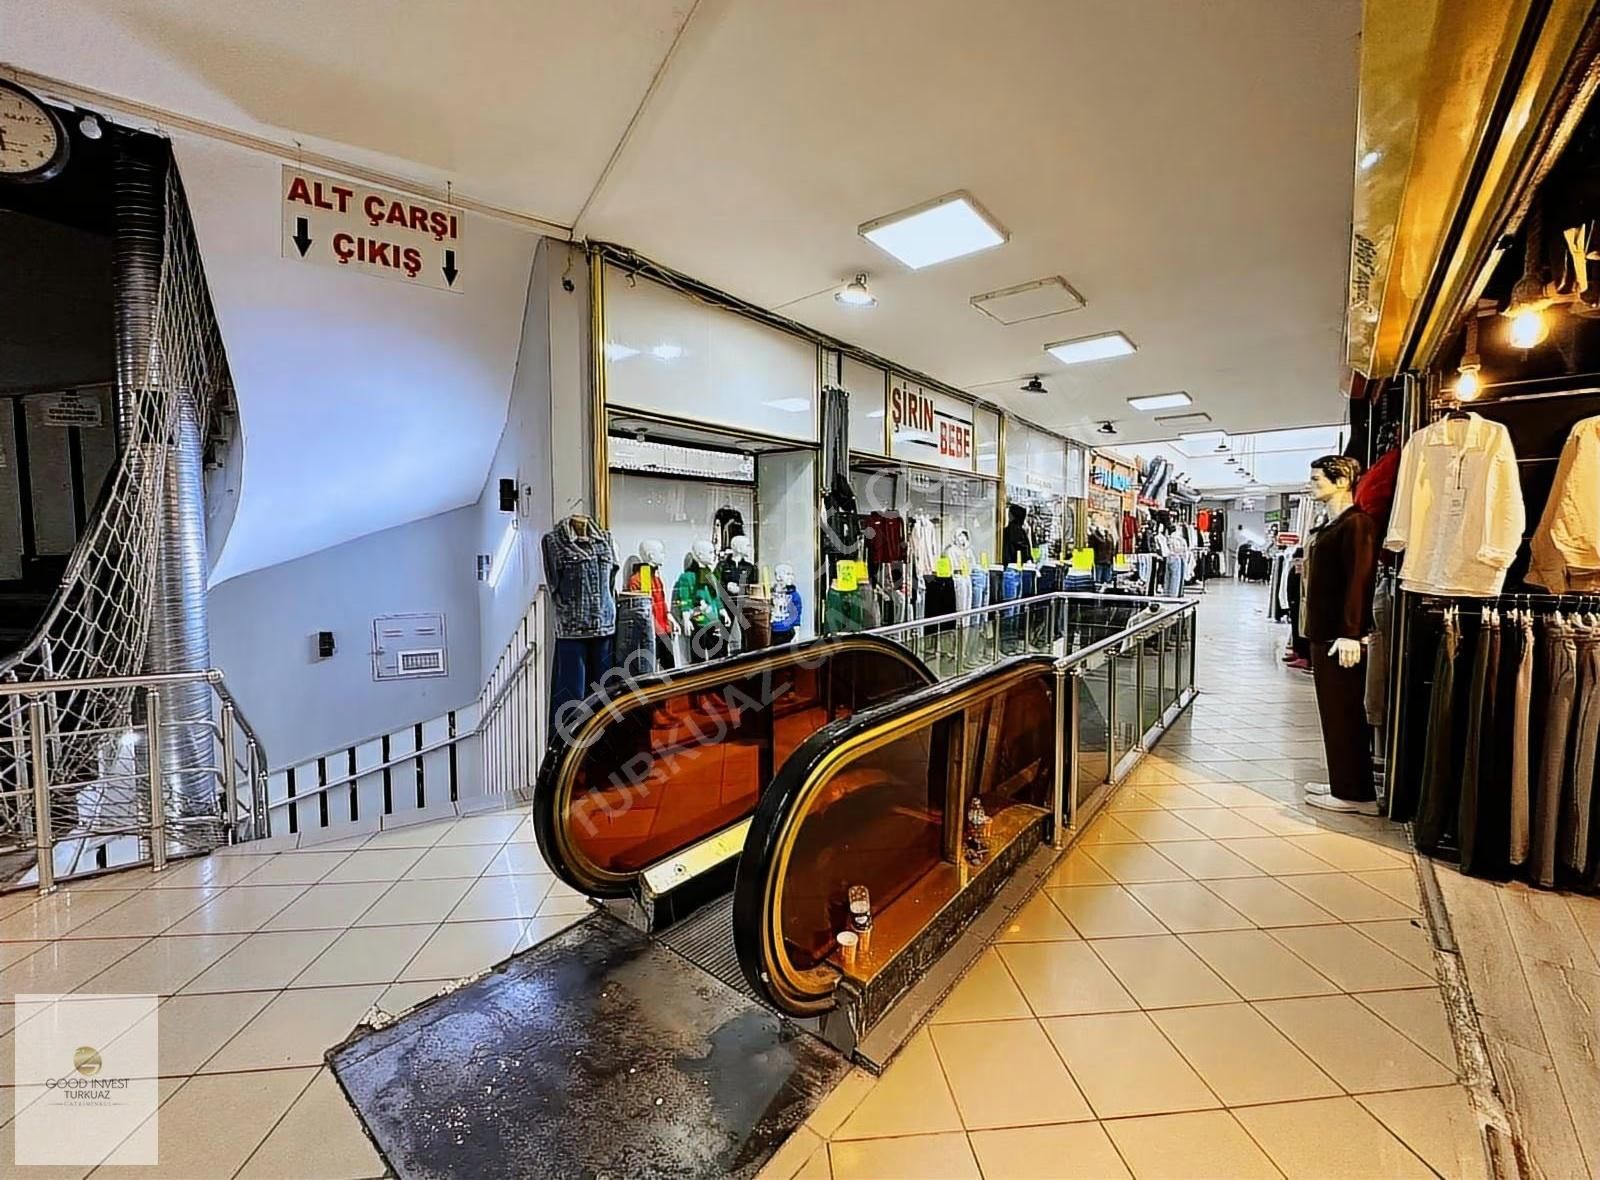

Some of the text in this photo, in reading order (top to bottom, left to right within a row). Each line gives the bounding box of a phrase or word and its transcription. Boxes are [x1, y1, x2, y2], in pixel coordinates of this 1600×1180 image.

[287, 176, 458, 242] ALT ÇARŞI
[332, 232, 422, 278] ÇIKIŞ
[892, 381, 934, 433] ŞİRİN
[940, 421, 971, 458] BEBE
